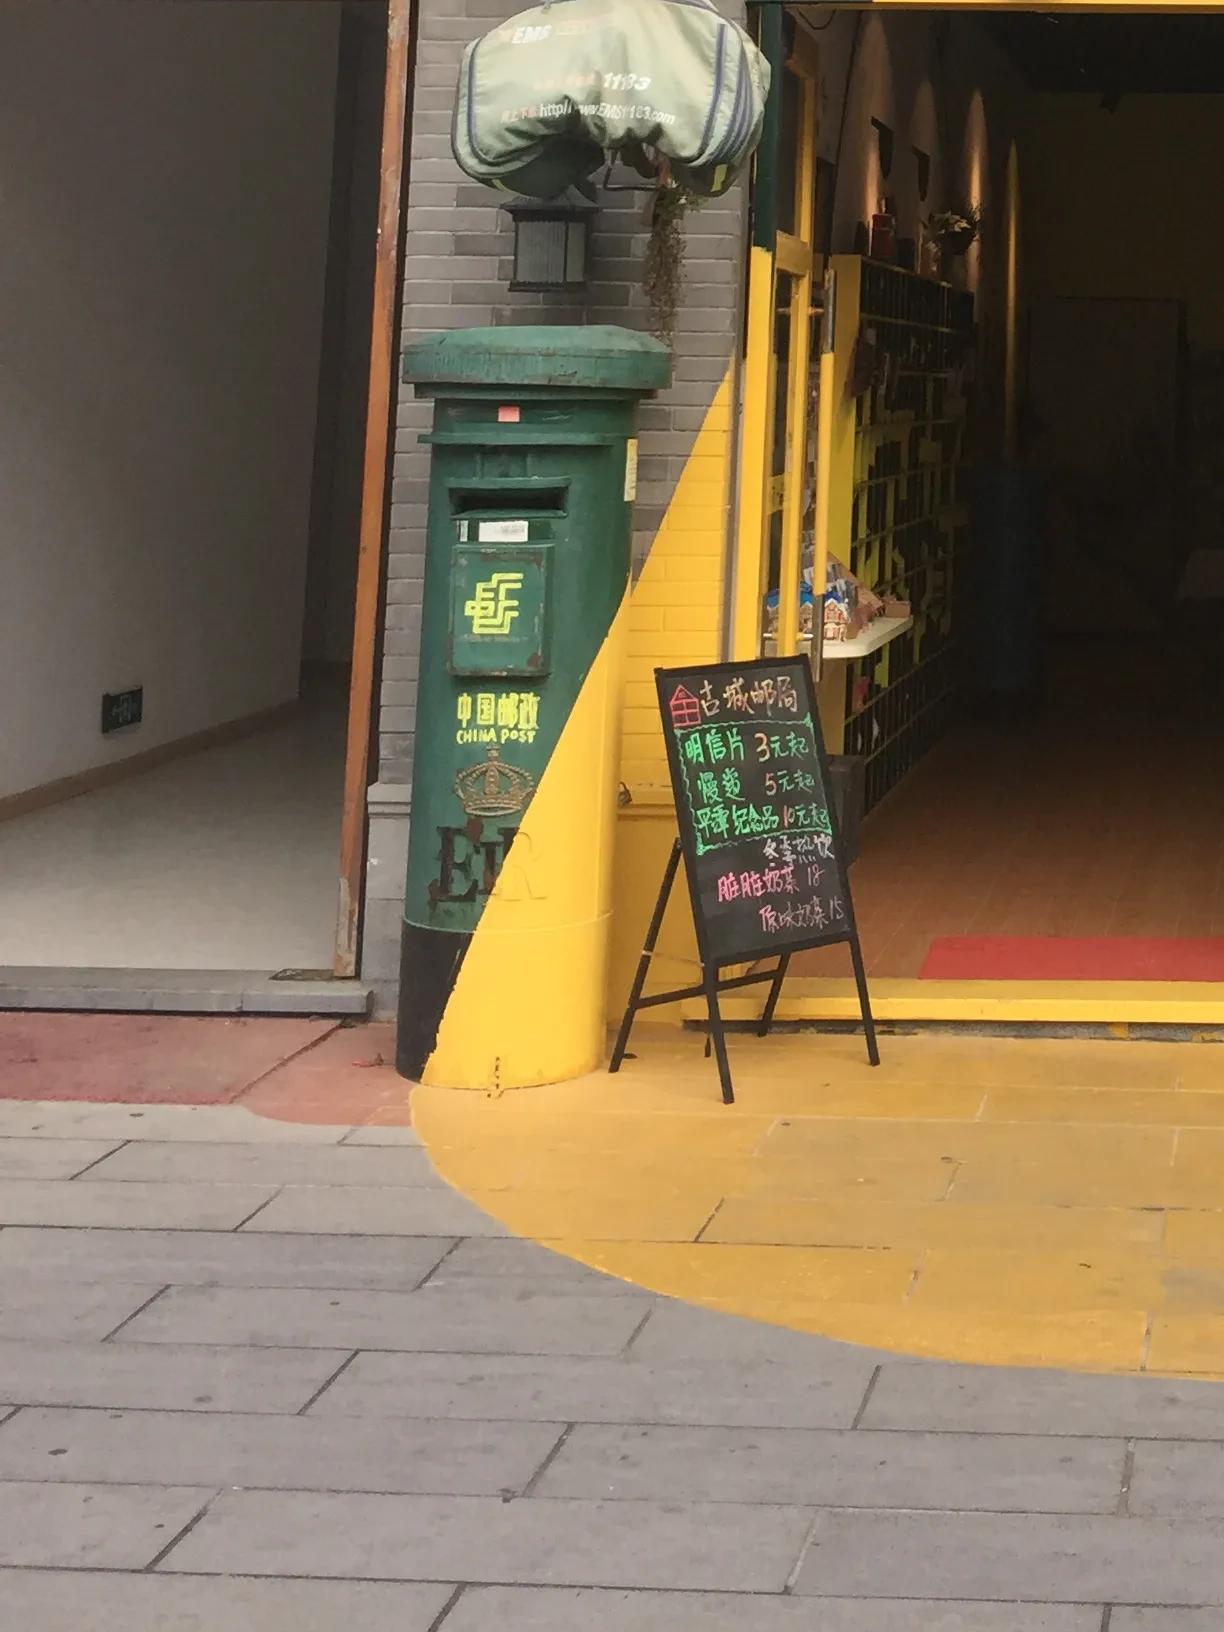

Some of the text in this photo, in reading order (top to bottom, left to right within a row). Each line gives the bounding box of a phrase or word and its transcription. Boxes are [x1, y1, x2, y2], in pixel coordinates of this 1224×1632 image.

[457, 691, 541, 730] 中国邮政
[699, 676, 798, 717] 古城邮局
[456, 728, 498, 744] CHINA
[684, 728, 809, 764] 明信片 3元起
[765, 769, 816, 796] 5元起
[783, 802, 830, 828] 10元起
